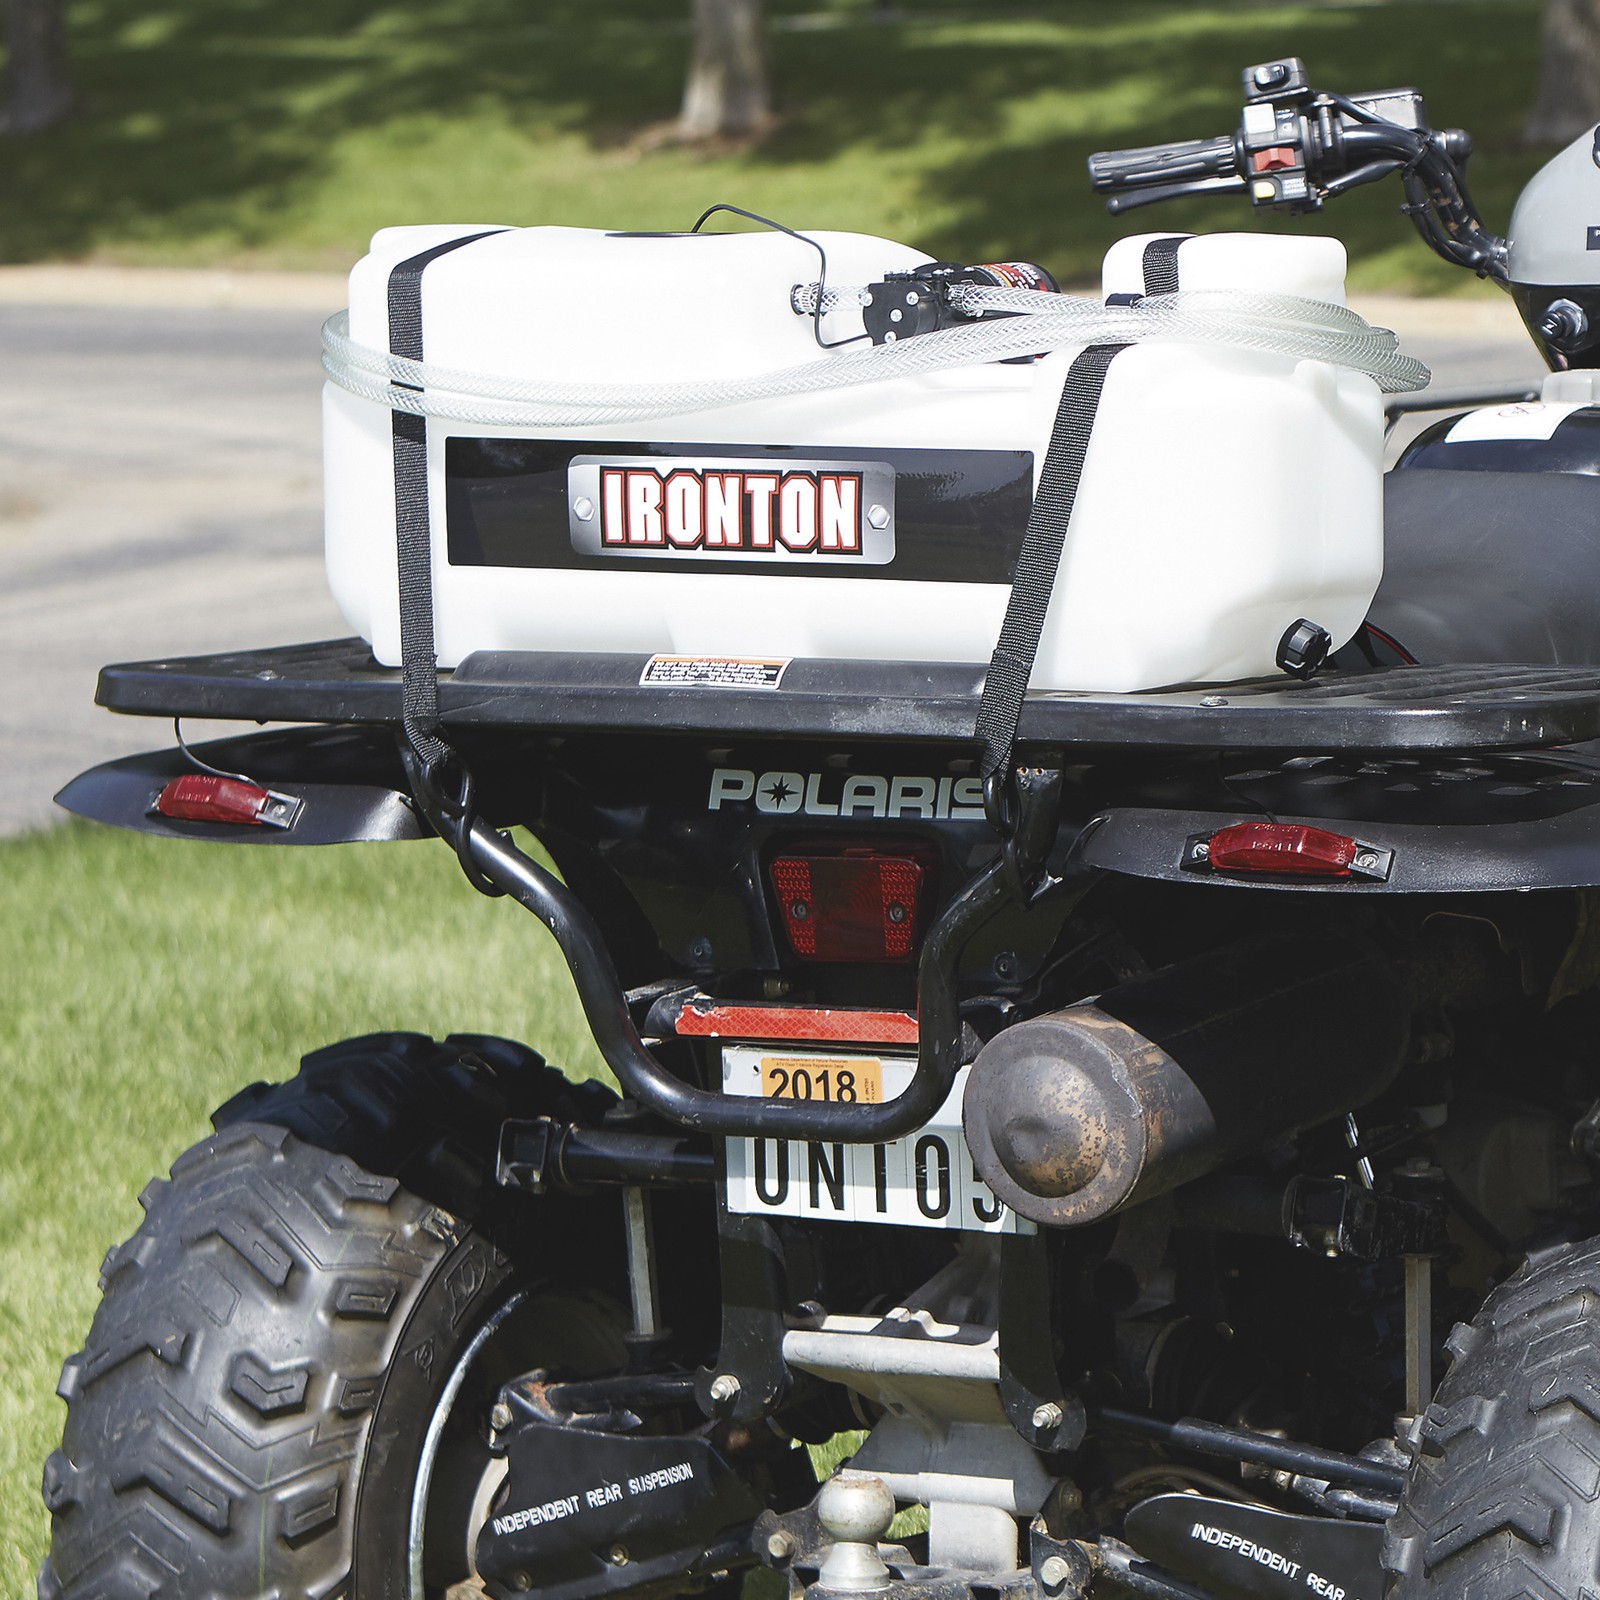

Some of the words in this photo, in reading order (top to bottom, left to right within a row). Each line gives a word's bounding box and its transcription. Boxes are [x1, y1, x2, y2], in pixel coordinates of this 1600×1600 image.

[602, 468, 863, 553] IRONTON
[708, 768, 987, 820] POLARIS
[769, 1068, 857, 1103] 2018
[492, 1494, 580, 1536] INDEPENDENT
[585, 1483, 624, 1509] REAR
[627, 1461, 694, 1495] SUSPENSION
[1191, 1522, 1301, 1579] INDEPENDENT
[1306, 1572, 1346, 1600] REAR
